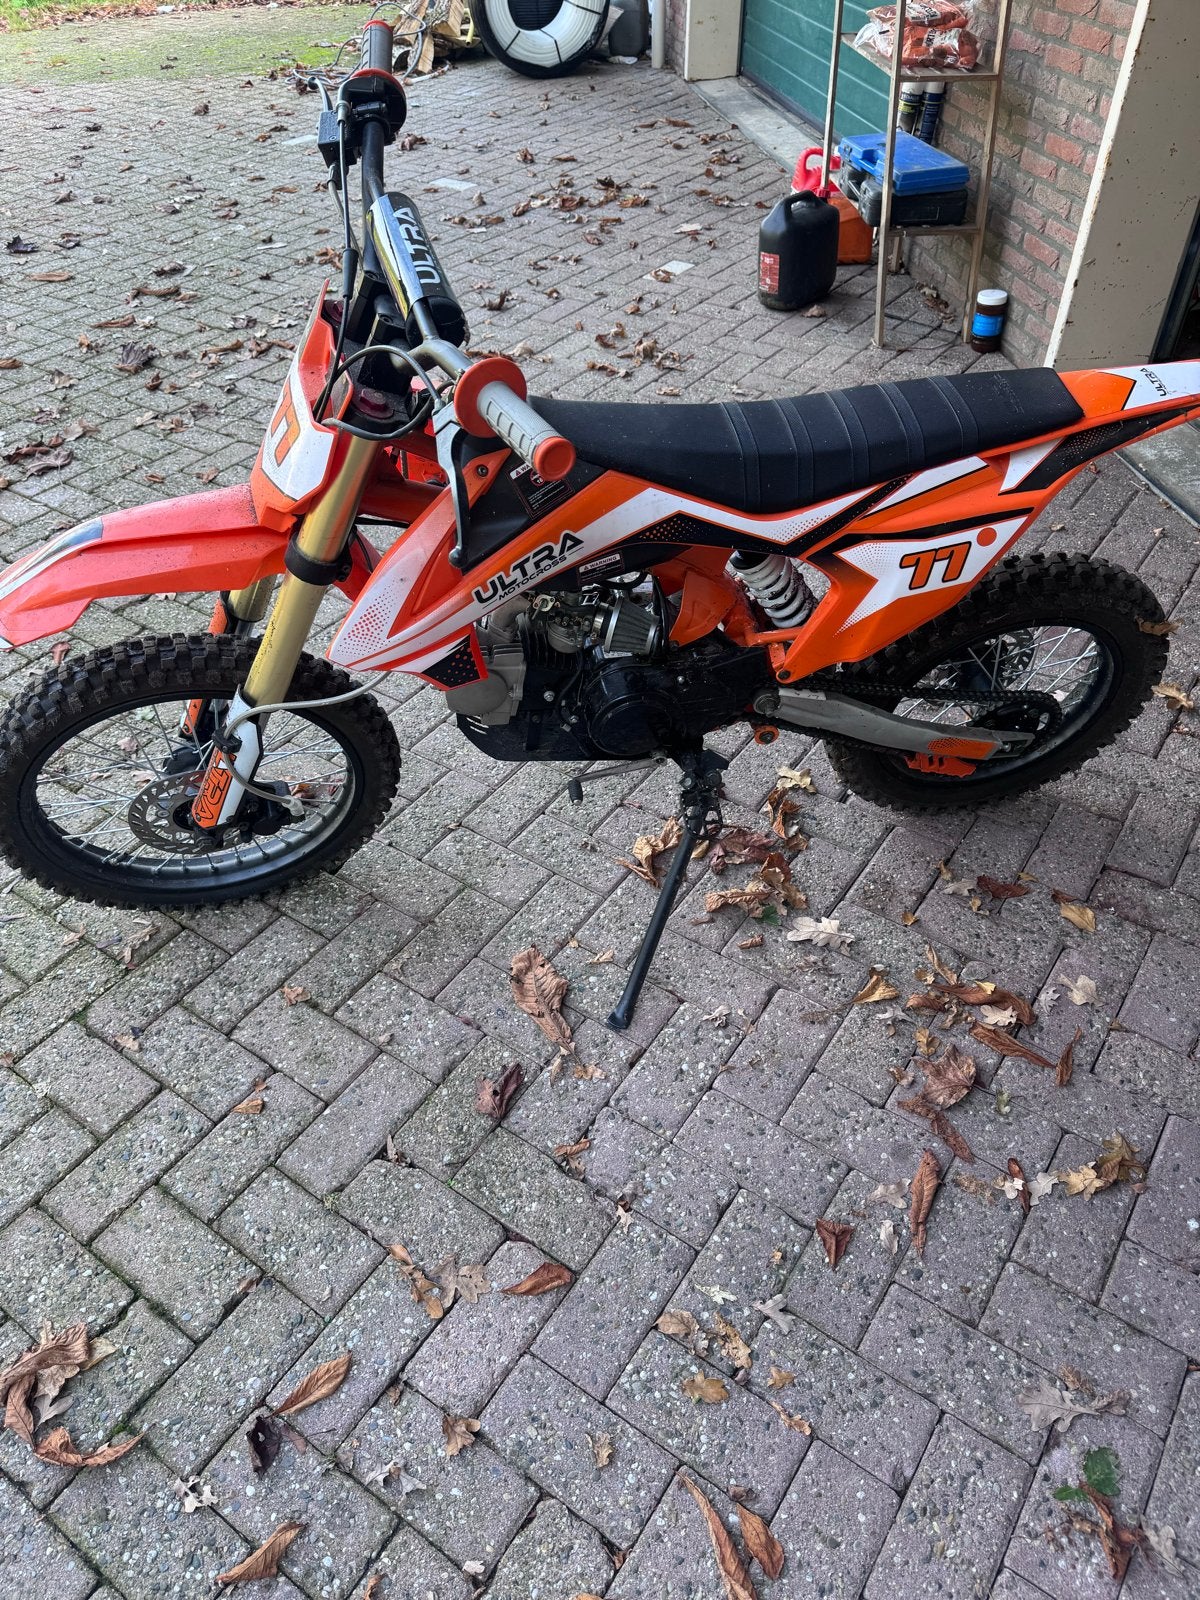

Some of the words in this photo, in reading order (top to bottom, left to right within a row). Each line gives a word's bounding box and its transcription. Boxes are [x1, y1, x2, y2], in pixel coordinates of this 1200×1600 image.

[393, 208, 441, 284] ULTRA
[1140, 367, 1167, 397] ULTRA
[474, 532, 584, 604] ULTRA
[499, 555, 568, 601] MOTOCROSS
[590, 556, 617, 568] WARNING
[899, 541, 972, 590] 77
